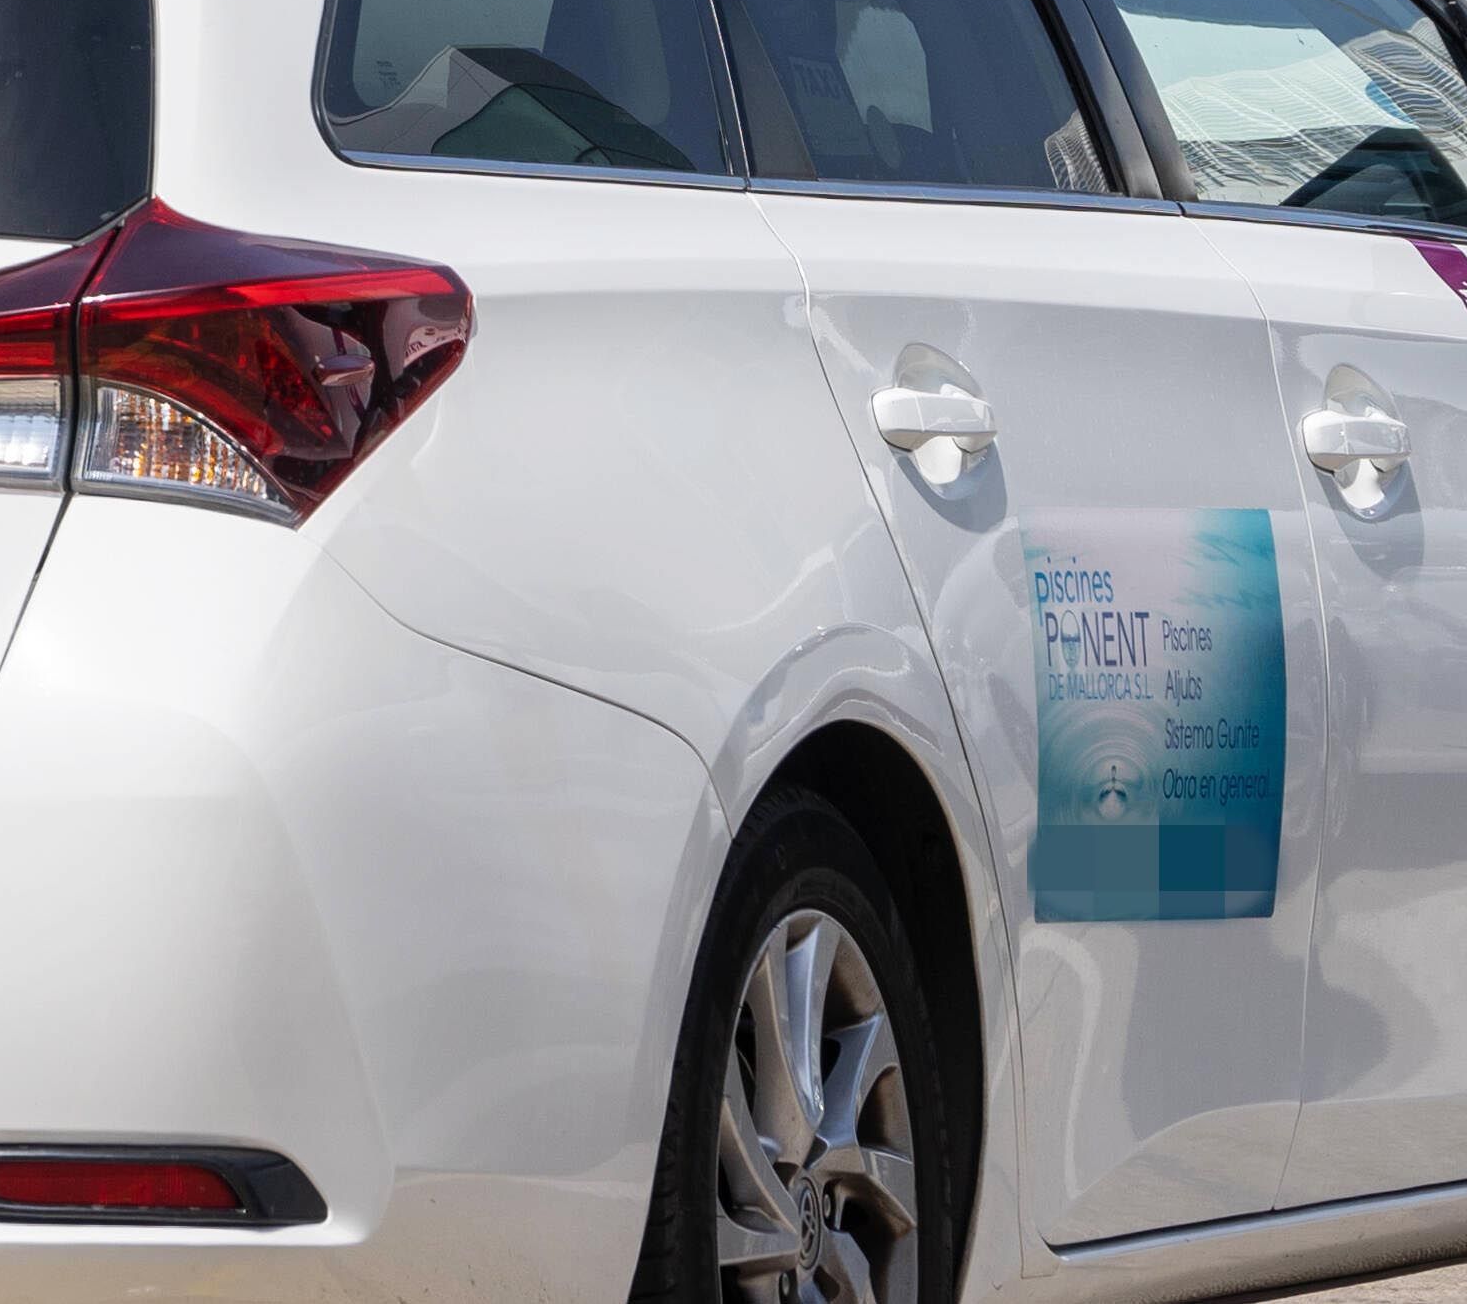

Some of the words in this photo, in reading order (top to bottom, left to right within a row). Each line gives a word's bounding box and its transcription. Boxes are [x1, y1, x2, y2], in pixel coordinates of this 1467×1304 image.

[1034, 557, 1114, 626] piscines
[1162, 620, 1213, 652] Piscines
[1049, 674, 1064, 700] DE
[1068, 674, 1132, 700] MALLORCA
[1165, 670, 1203, 706] Aljubs
[1165, 718, 1214, 750] Sistema
[1217, 719, 1260, 750] Gunite
[1162, 769, 1198, 800] Obra
[1200, 777, 1215, 800] en
